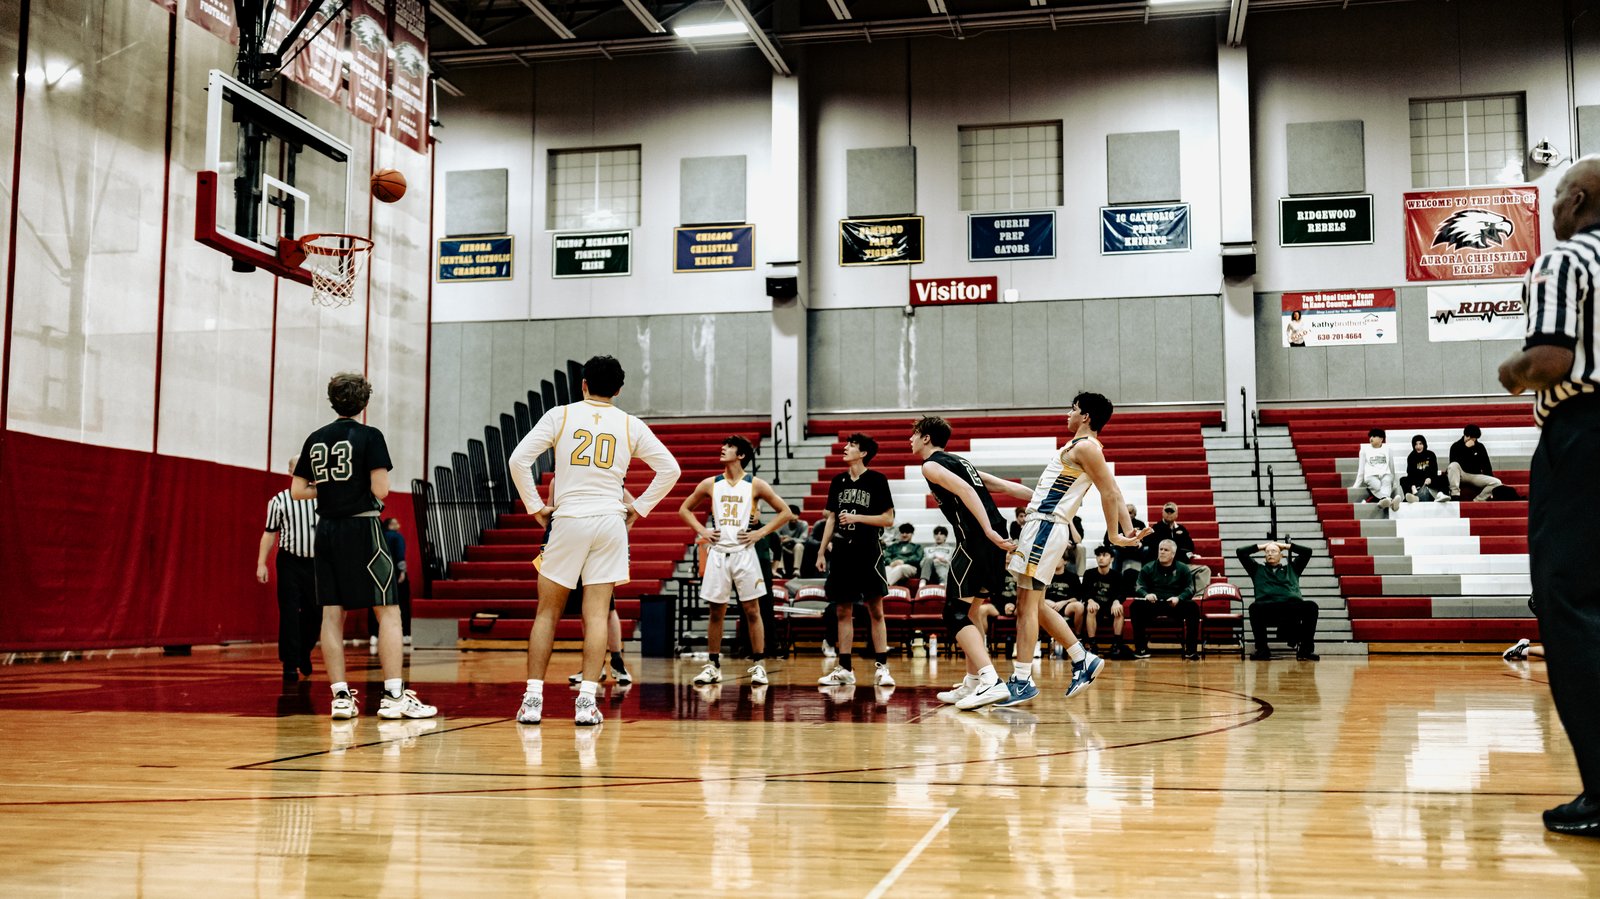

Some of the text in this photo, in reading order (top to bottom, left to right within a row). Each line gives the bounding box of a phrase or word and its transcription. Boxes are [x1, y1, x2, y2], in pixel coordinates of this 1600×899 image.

[1407, 199, 1452, 209] WELCOME
[1455, 198, 1467, 206] TO
[1470, 197, 1490, 205] THE
[1493, 195, 1520, 204] HOME
[1130, 211, 1175, 222] CATHOLIC
[1297, 209, 1356, 220] RIDGEWOOD
[994, 219, 1030, 228] GUERIN
[1132, 224, 1158, 233] PREP
[1307, 222, 1346, 233] REBELS
[696, 232, 733, 241] CHICAGO
[999, 231, 1024, 241] PREP
[1124, 236, 1167, 246] KNIGHTS
[557, 239, 584, 248] BISHOP
[869, 237, 893, 246] PARK
[459, 243, 492, 252] AURORA
[690, 244, 738, 254] CHRISTIAN
[865, 248, 898, 257] TIGERS
[994, 244, 1030, 254] GATORS
[440, 254, 511, 264] CENTRAL CATHOLIC
[575, 249, 612, 259] FIGHTING
[1420, 251, 1527, 265] AURORA CHRISTIAN
[581, 261, 605, 270] IRISH
[694, 256, 733, 265] KNIGHTS
[453, 266, 497, 276] CHARGERS
[1453, 264, 1494, 275] EAGLES
[915, 281, 992, 301] Visitor
[1457, 300, 1521, 314] RIDGE
[570, 428, 617, 470] 20
[309, 440, 353, 483] 23
[722, 503, 738, 518] 34
[1208, 586, 1236, 597] CHRISTIAN
